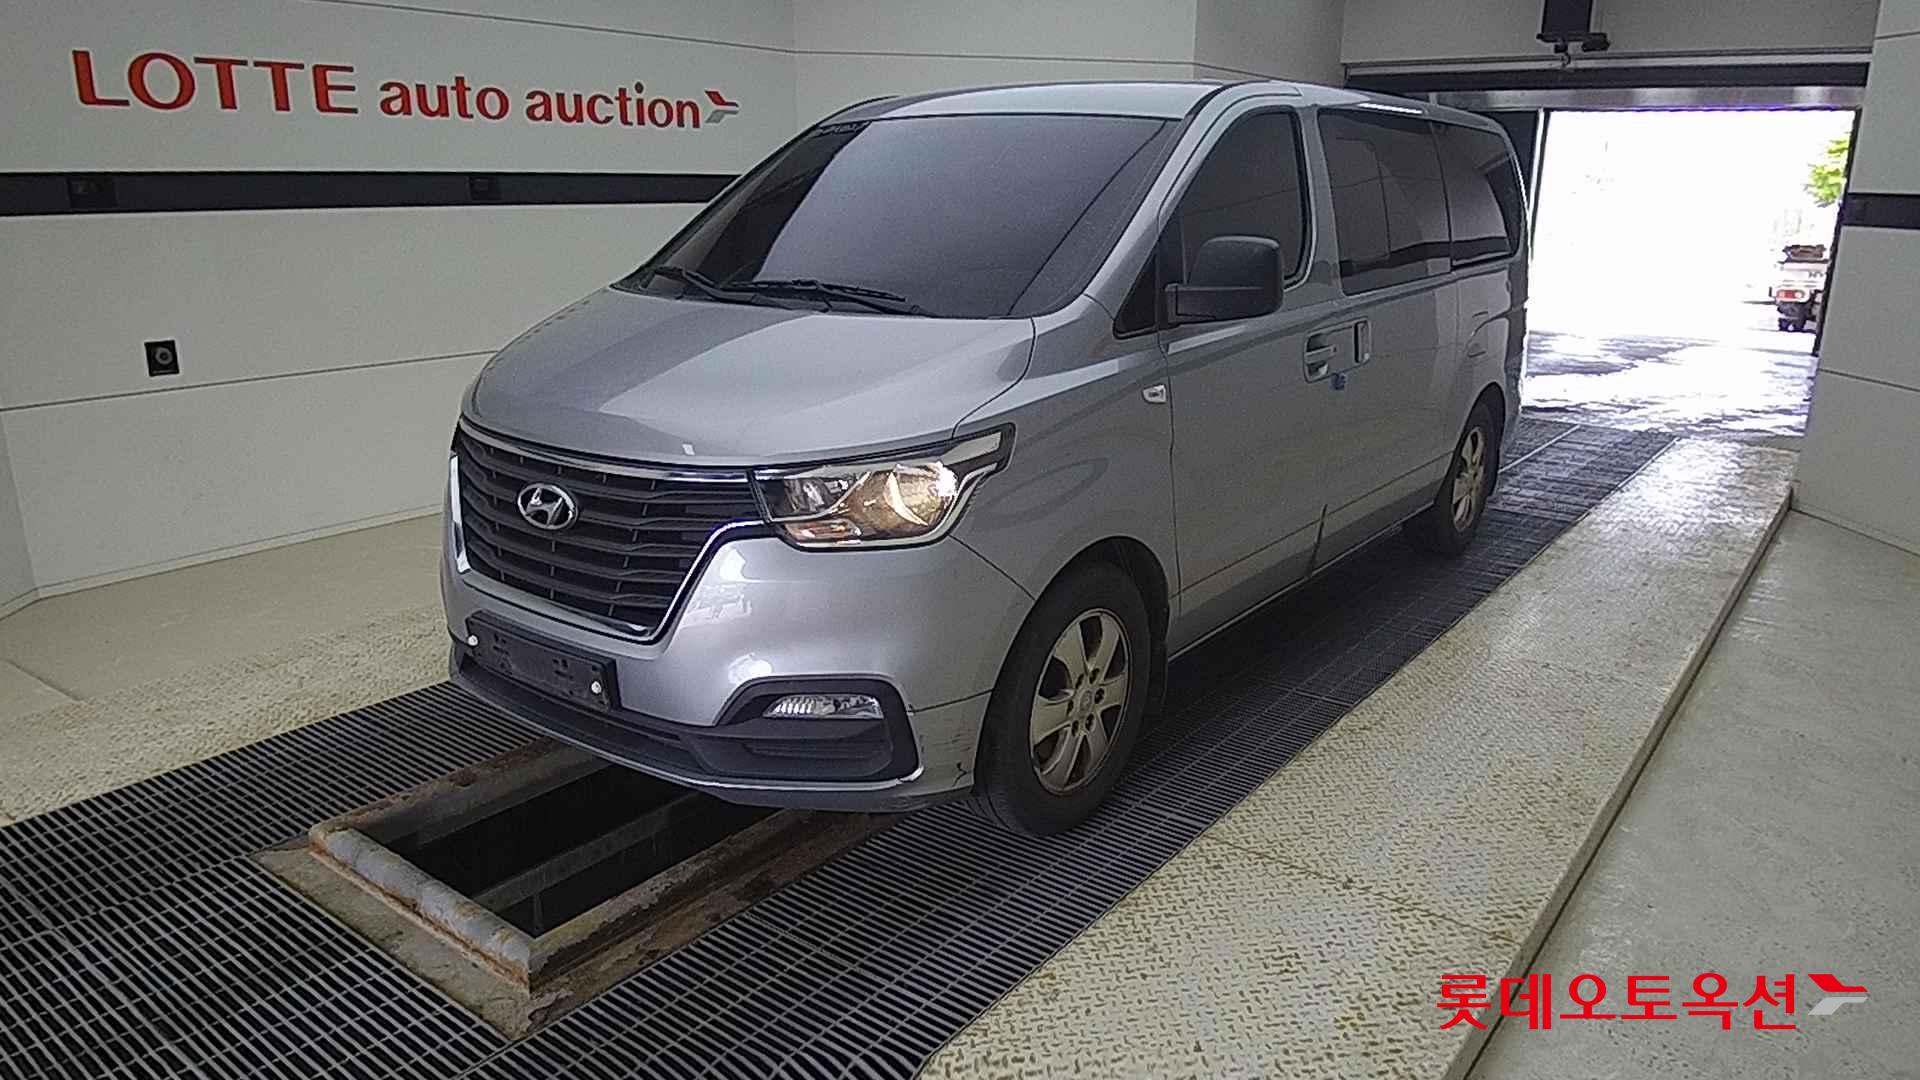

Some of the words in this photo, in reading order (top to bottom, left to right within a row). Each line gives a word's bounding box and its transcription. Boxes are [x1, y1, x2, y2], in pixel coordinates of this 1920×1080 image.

[72, 50, 359, 115] LOTTE
[379, 76, 510, 121] auto
[525, 81, 701, 129] auction
